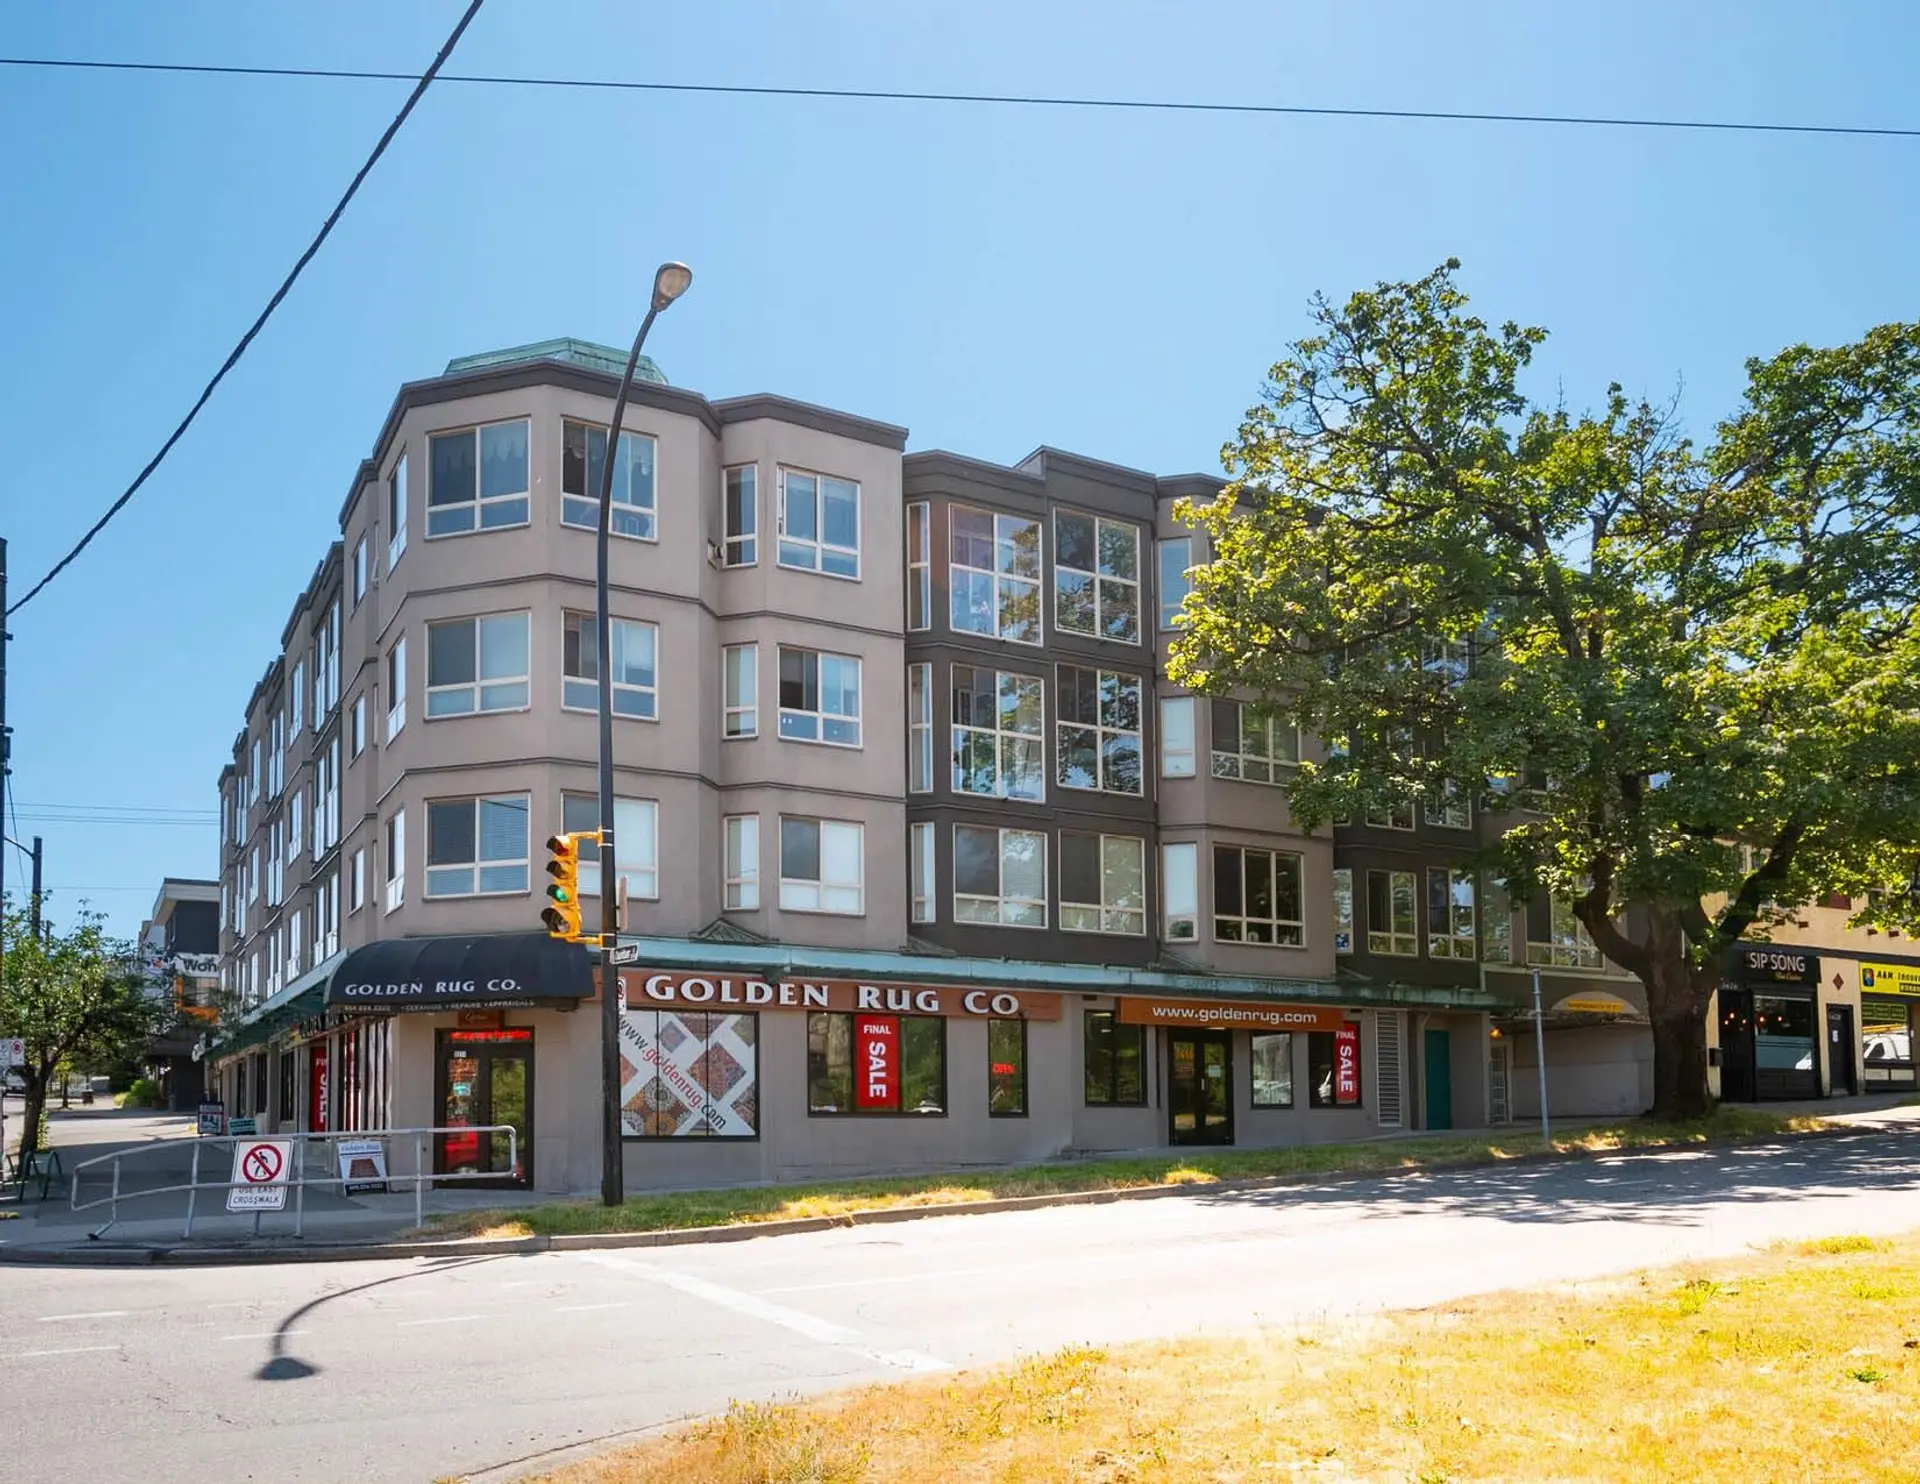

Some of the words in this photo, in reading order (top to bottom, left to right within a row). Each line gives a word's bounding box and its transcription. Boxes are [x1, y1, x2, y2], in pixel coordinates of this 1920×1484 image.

[1749, 952, 1768, 969] SIP
[1770, 954, 1806, 972] SONG
[345, 982, 423, 996] GOLDEN
[435, 980, 475, 993] RUG
[487, 978, 521, 992] CO.
[645, 975, 829, 1008] GOLDEN
[857, 985, 940, 1013] RUG
[964, 991, 1019, 1016] CO
[1152, 1006, 1317, 1025] www.goldenrug.com
[863, 1024, 892, 1035] FINAL
[1335, 1030, 1356, 1040] FINAL
[869, 1041, 887, 1098] SALE
[1340, 1045, 1353, 1093] SALE
[233, 1195, 280, 1204] CROSSWALK
